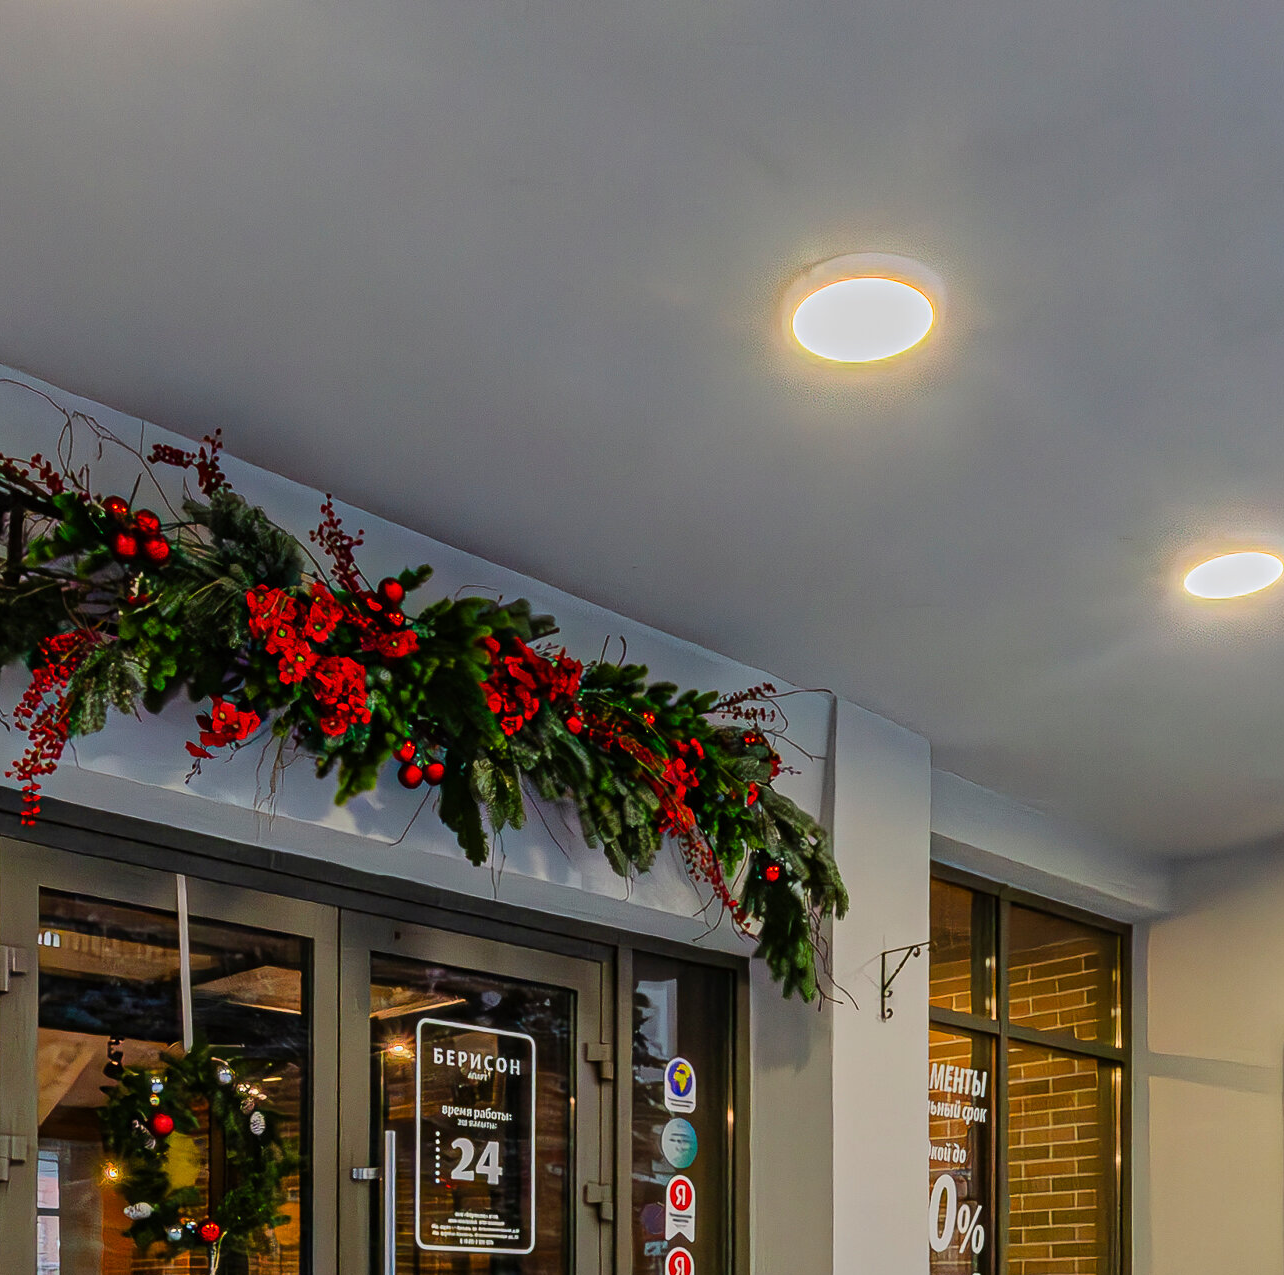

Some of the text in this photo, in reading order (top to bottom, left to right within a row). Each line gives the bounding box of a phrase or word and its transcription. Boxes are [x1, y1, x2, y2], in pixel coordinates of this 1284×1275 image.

[433, 1047, 521, 1076] БЕРИСОН
[929, 1063, 987, 1098] МЕНТЫ
[441, 1105, 513, 1121] время работы:
[451, 1137, 503, 1186] 24
[952, 1143, 967, 1164] до
[675, 1184, 686, 1206] Я
